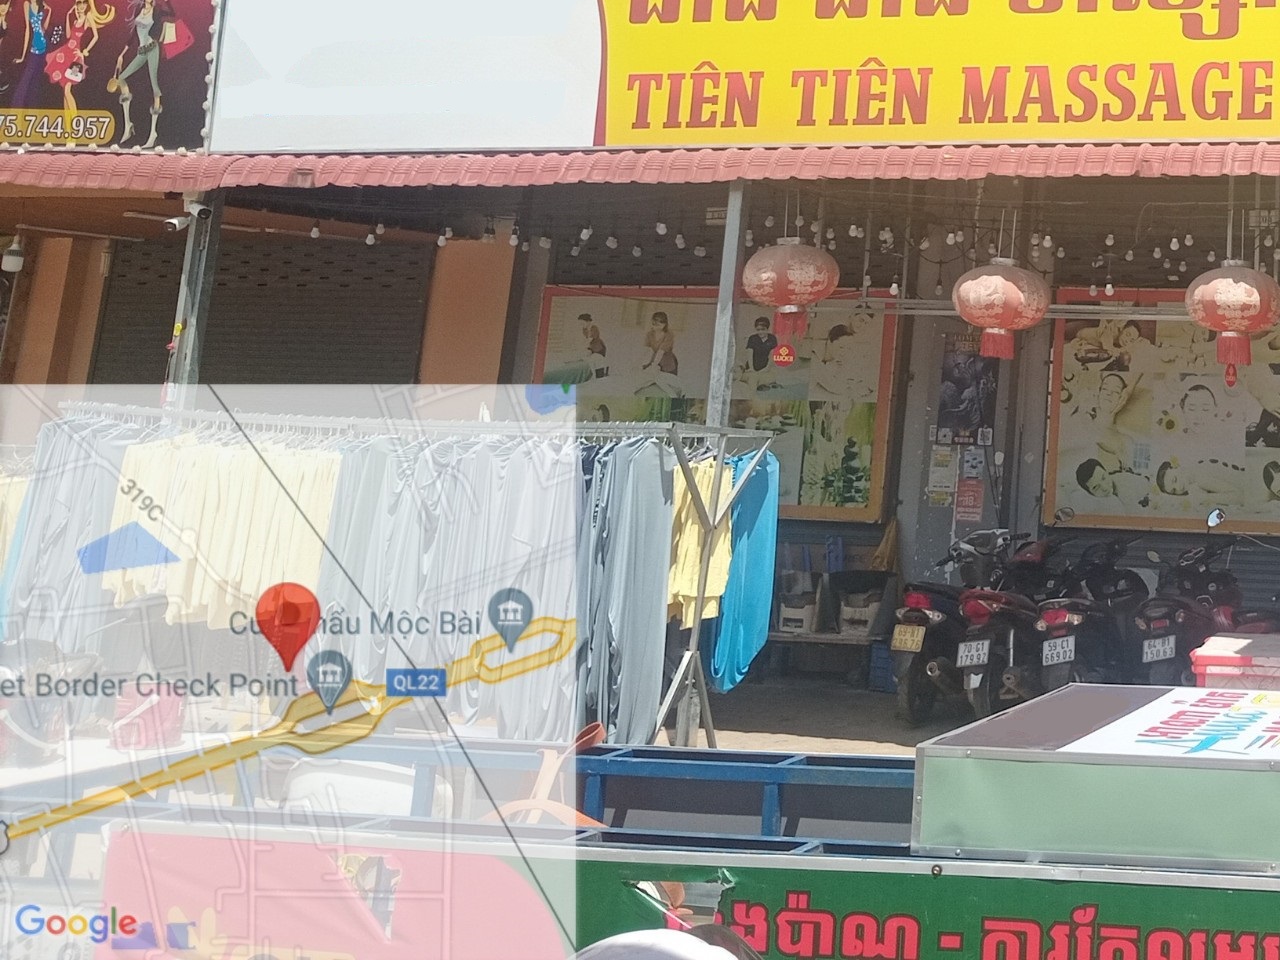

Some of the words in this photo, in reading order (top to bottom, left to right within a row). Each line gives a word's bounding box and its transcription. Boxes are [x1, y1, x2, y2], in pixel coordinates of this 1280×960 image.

[627, 60, 764, 130] TIÊN
[791, 57, 933, 127] TIÊN
[958, 61, 1275, 125] MASSAGE
